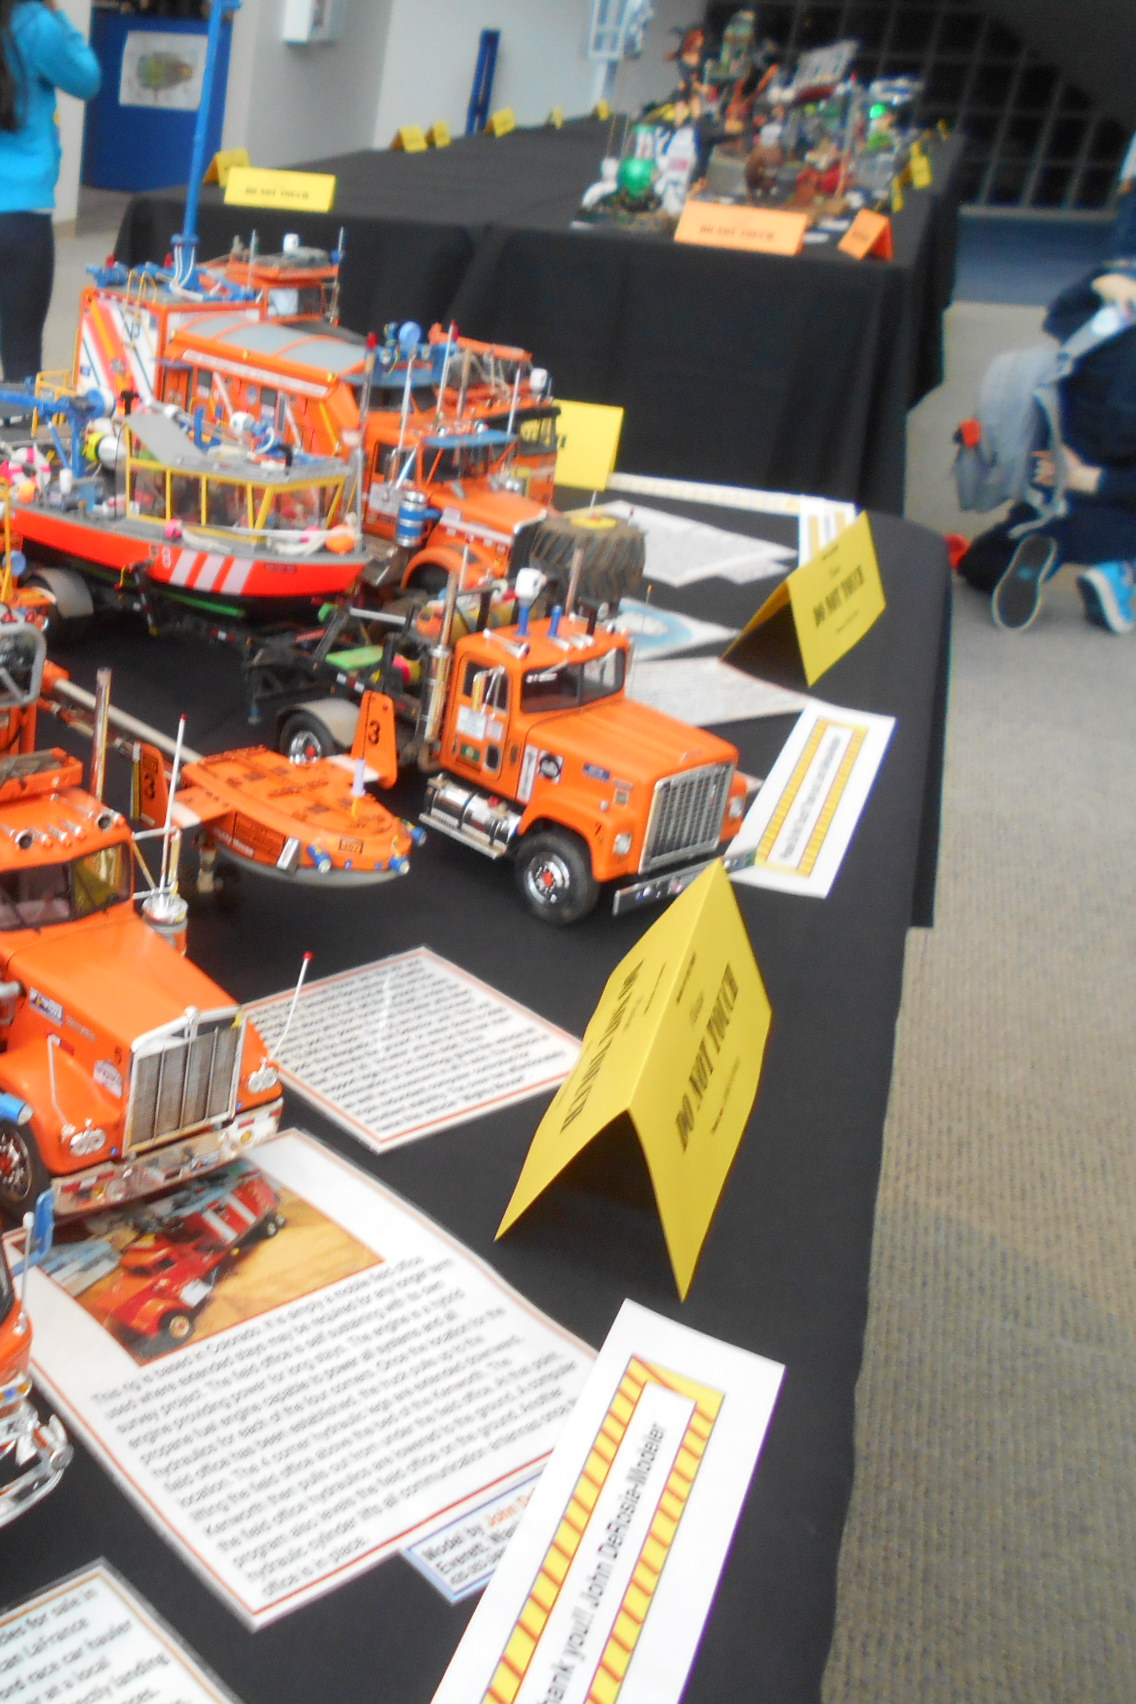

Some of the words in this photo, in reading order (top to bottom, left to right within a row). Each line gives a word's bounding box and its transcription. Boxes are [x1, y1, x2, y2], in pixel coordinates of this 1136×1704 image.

[367, 720, 381, 745] 3
[675, 1093, 694, 1155] DO
[689, 1035, 714, 1112] NOT
[707, 961, 739, 1054] TOUCH
[537, 1659, 575, 1704] hank
[579, 1561, 614, 1609] John
